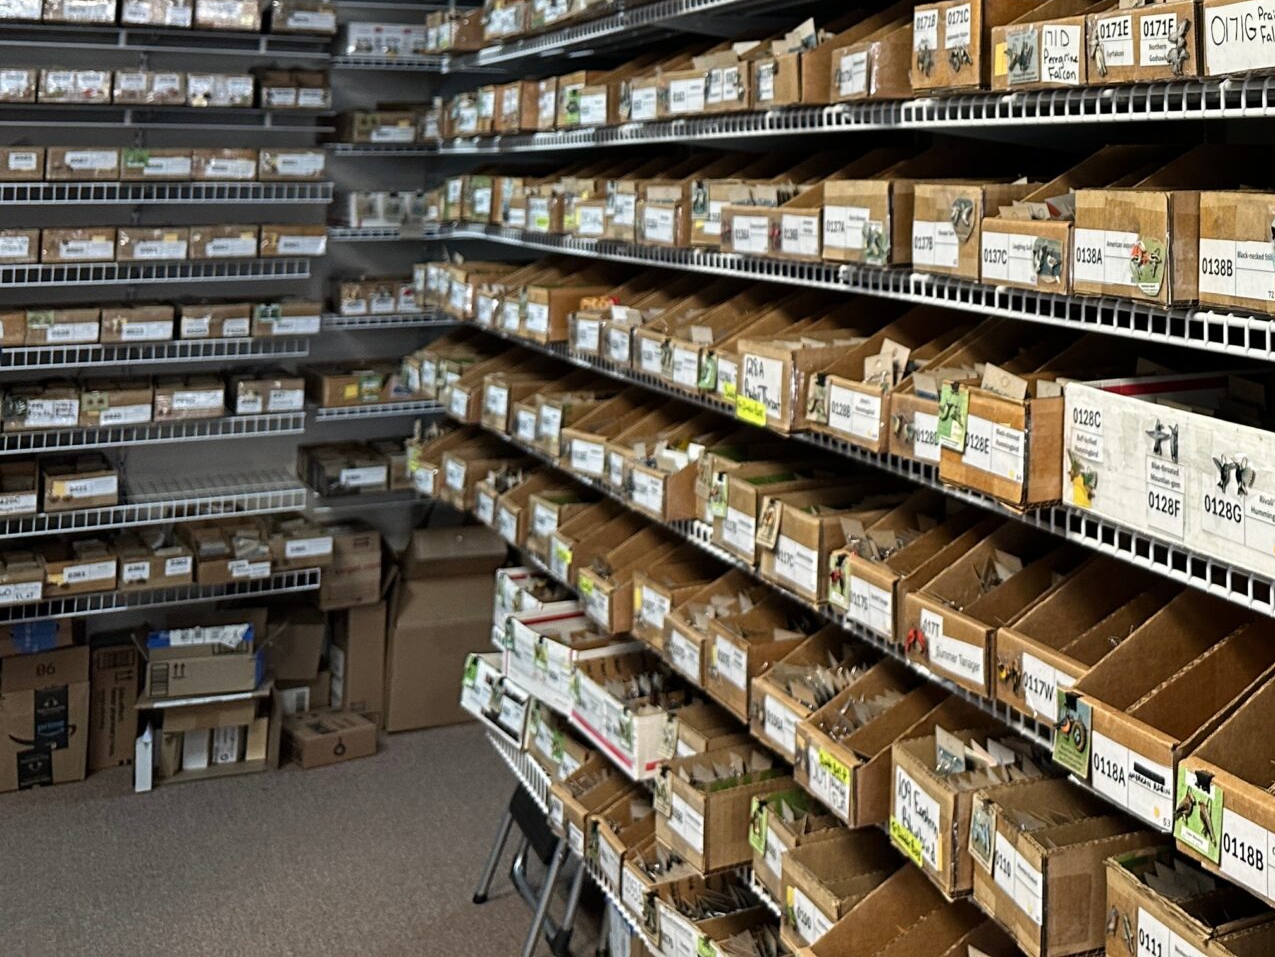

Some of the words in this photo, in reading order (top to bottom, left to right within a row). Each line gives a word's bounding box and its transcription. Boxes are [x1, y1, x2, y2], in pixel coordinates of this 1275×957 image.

[916, 12, 936, 31] 0171B
[947, 5, 969, 25] 0171C
[1100, 19, 1129, 39] 0171E
[1143, 17, 1174, 37] 0171F
[1047, 66, 1077, 81] Falcon
[983, 247, 1008, 265] 0137C
[1076, 246, 1102, 265] 0138A
[1202, 257, 1233, 277] 0138B
[1072, 407, 1102, 428] 0128C
[965, 430, 990, 455] 0128E
[1148, 491, 1181, 518] 0128F
[1204, 494, 1242, 524] 0128G
[934, 645, 958, 664] Summer
[958, 653, 981, 673] Tanager
[1023, 671, 1055, 702] 0117W
[1093, 752, 1126, 787] 0118A
[1223, 832, 1264, 871] 0118B
